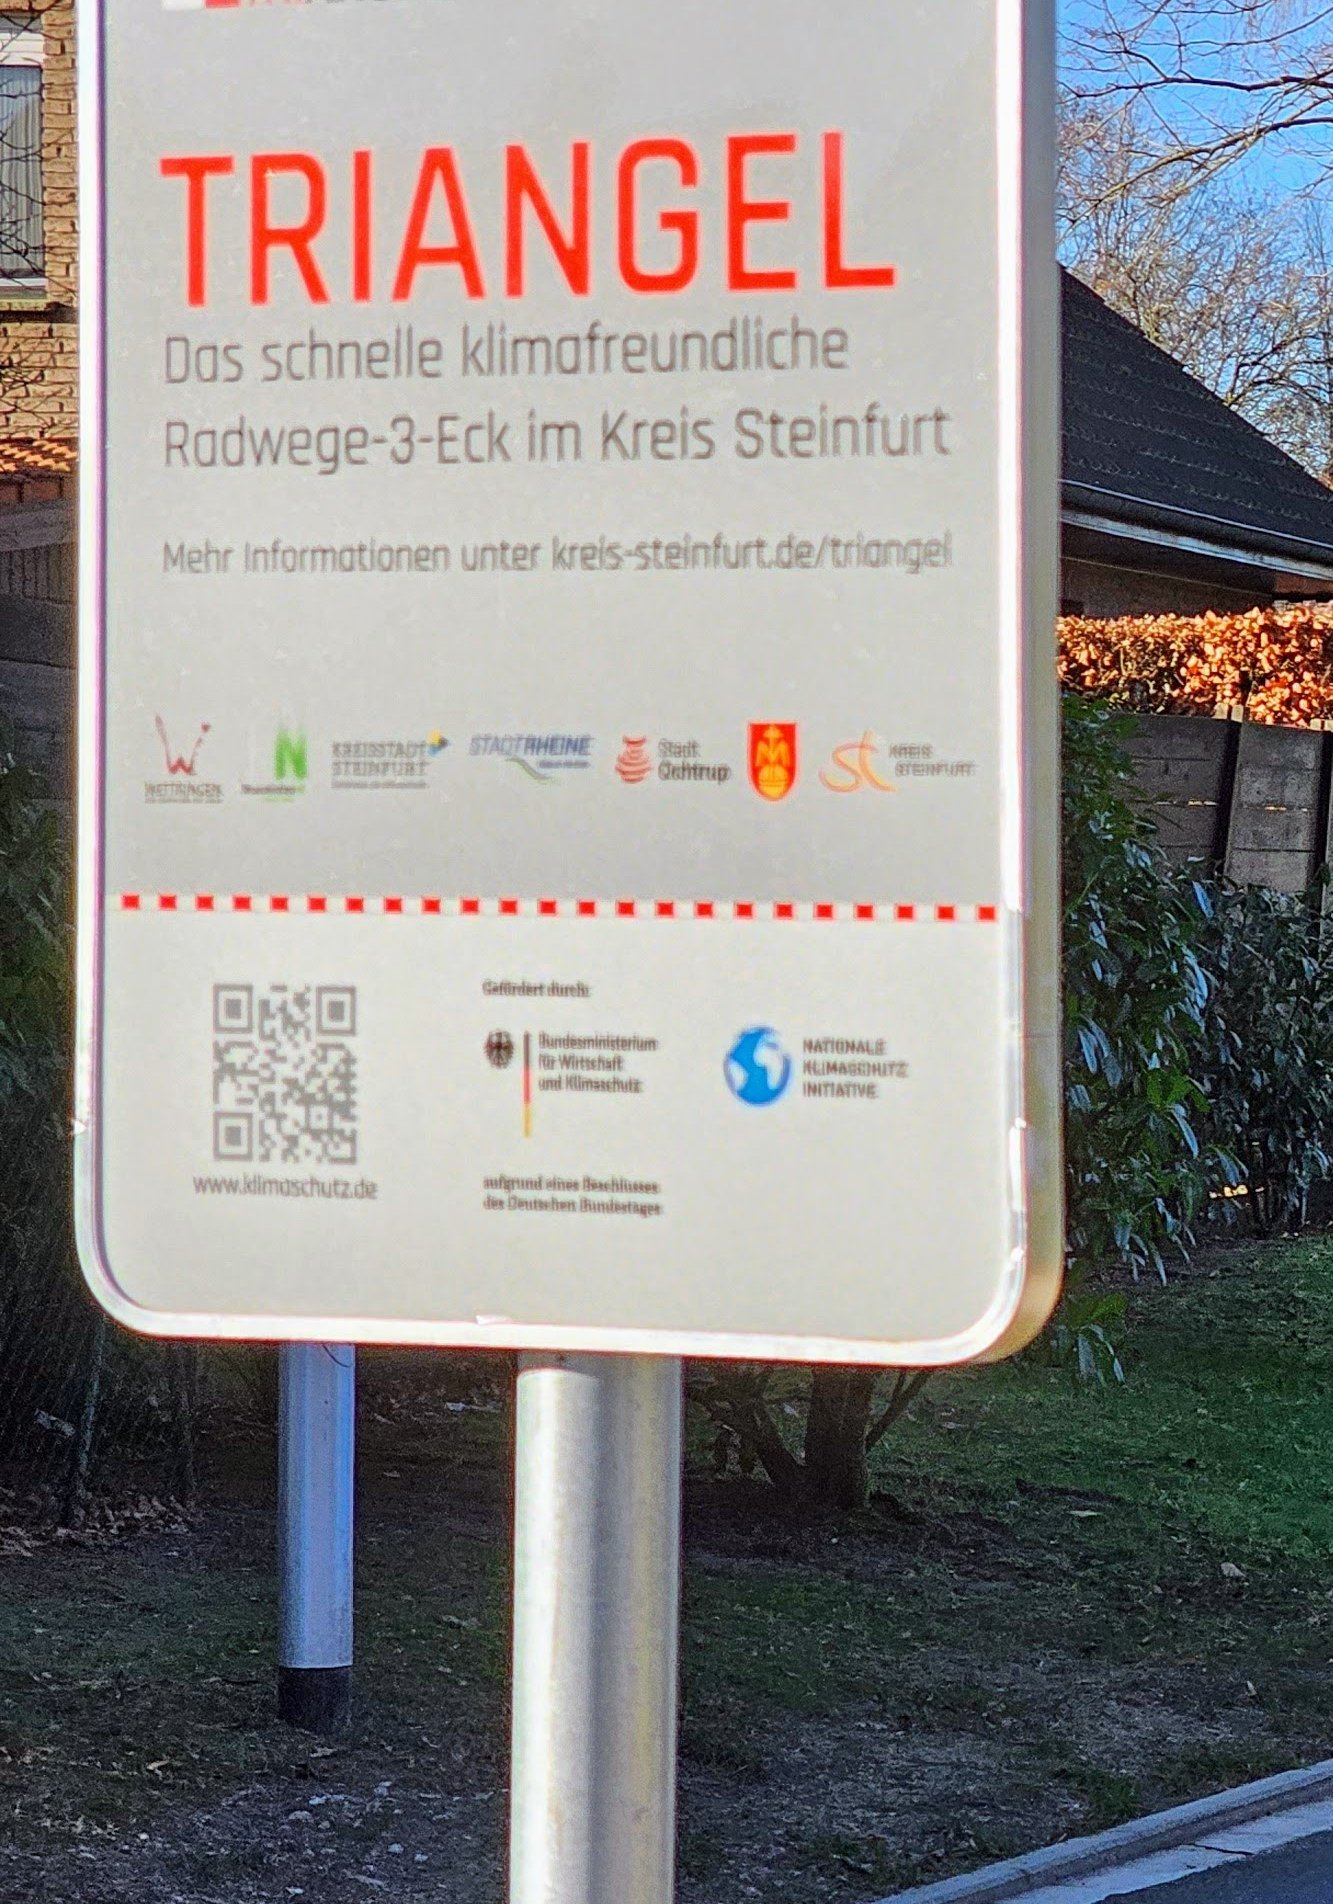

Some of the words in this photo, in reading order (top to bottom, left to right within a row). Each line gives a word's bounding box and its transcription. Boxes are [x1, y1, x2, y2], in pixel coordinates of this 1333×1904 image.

[160, 131, 896, 307] TRIANGEL
[164, 335, 244, 384] Das
[260, 322, 443, 382] schnelle
[460, 315, 850, 377] klimafreundliche
[164, 408, 513, 475] Radwege-3-Eck
[527, 406, 582, 462] im
[601, 404, 716, 461] Kreis
[734, 402, 952, 459] Steinfurt
[162, 538, 235, 574] Mehr
[243, 536, 451, 573] Informationen
[459, 537, 542, 572] unter
[551, 529, 953, 574] kreis-steinfurt.de/triangel
[657, 738, 699, 758] Stadt
[657, 760, 732, 785] Ochtrup
[482, 979, 545, 997] Gefördert
[538, 1031, 658, 1051] Bundesministerium
[802, 1037, 887, 1056] NATIONALE
[538, 1055, 556, 1071] für
[559, 1055, 624, 1072] Wirtschaft
[802, 1059, 910, 1078] KLIMASCHUTZ
[538, 1075, 562, 1091] und
[565, 1075, 642, 1094] Klimaschutz
[802, 1082, 879, 1100] INITIATIVE
[192, 1174, 379, 1200] www.klimaschutz.de
[483, 1174, 543, 1192] aufgrund
[483, 1194, 505, 1211] des
[507, 1195, 577, 1213] Deutschen
